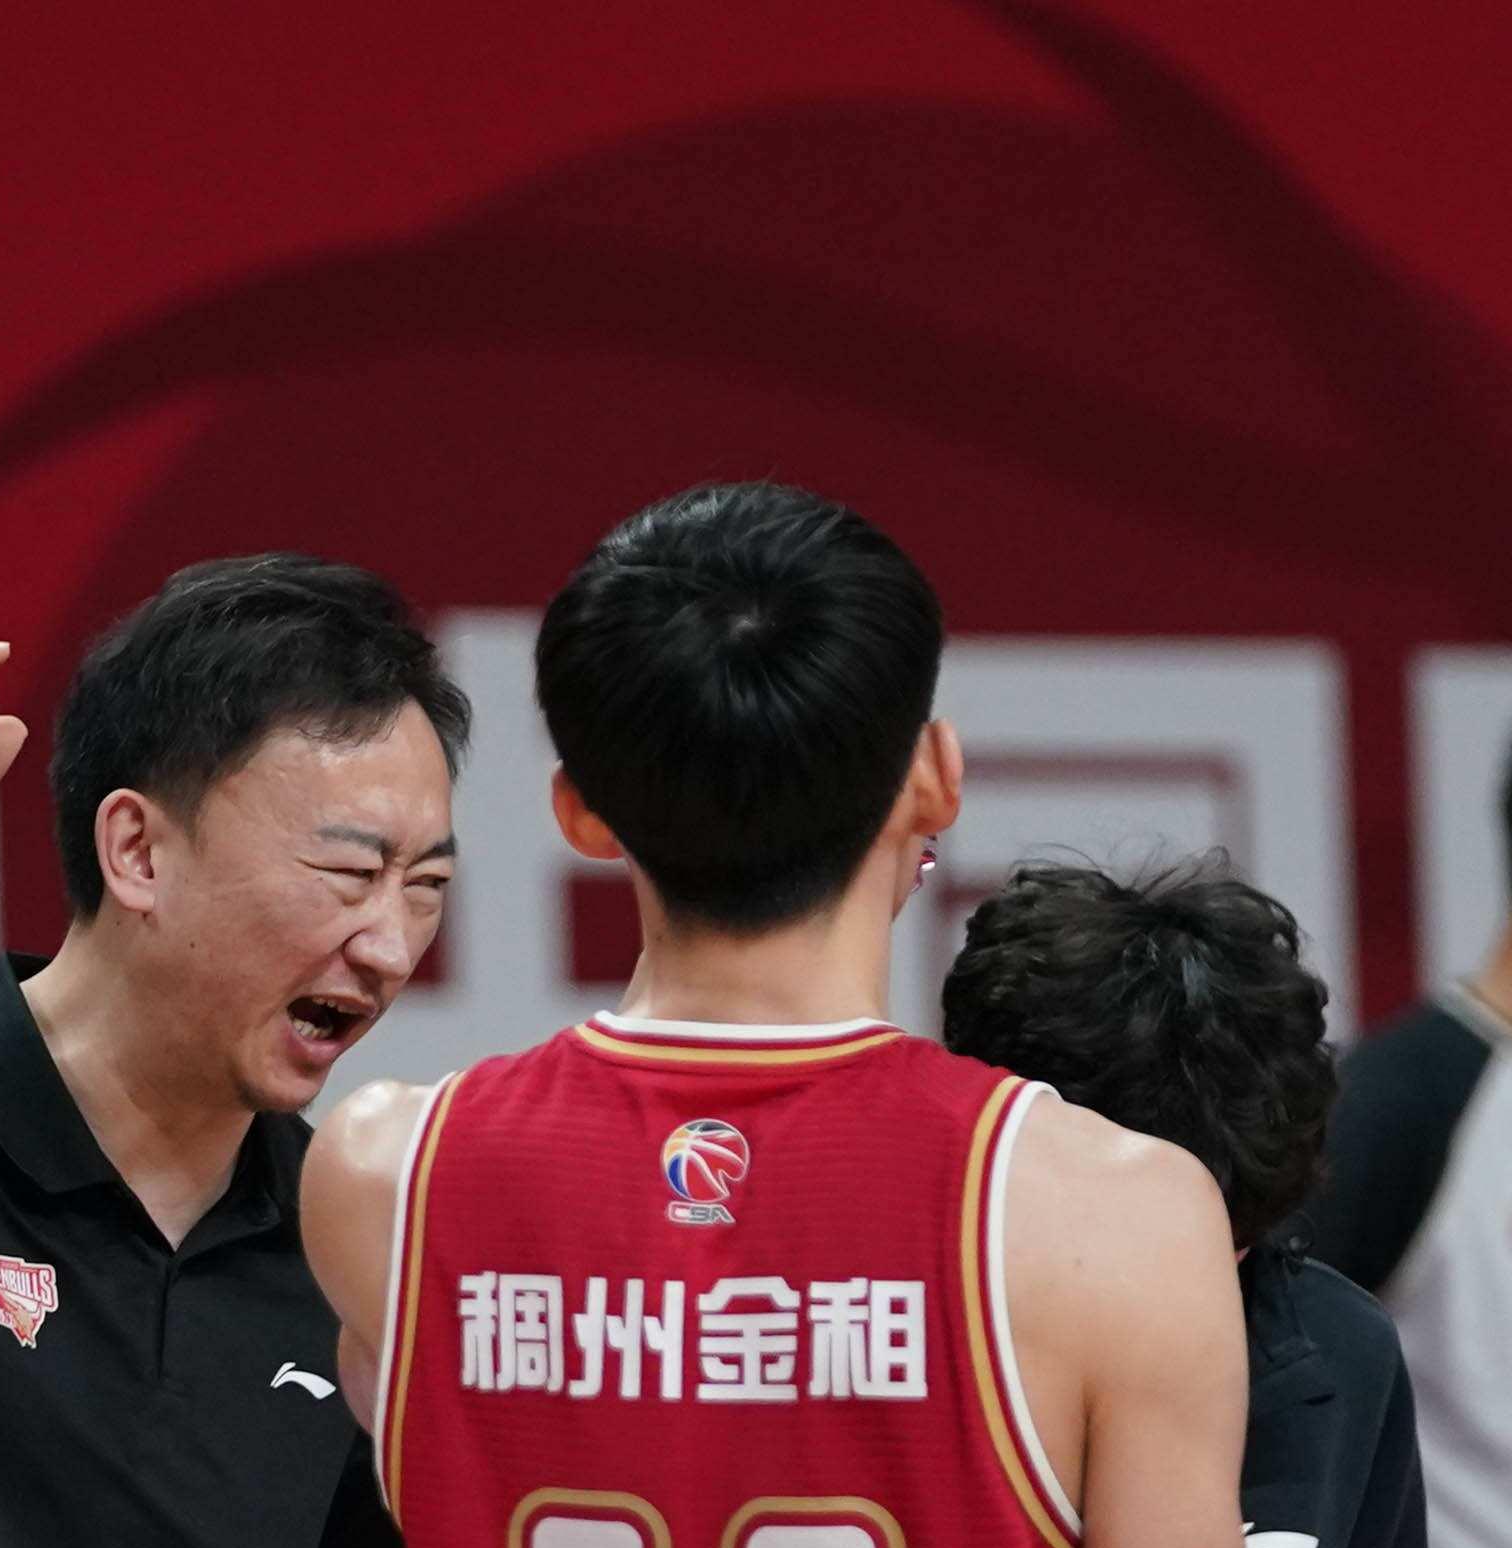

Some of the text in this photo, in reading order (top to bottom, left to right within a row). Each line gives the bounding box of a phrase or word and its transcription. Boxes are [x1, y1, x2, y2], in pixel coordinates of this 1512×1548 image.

[669, 1201, 736, 1224] CBA
[458, 1270, 928, 1401] 稠州金租
